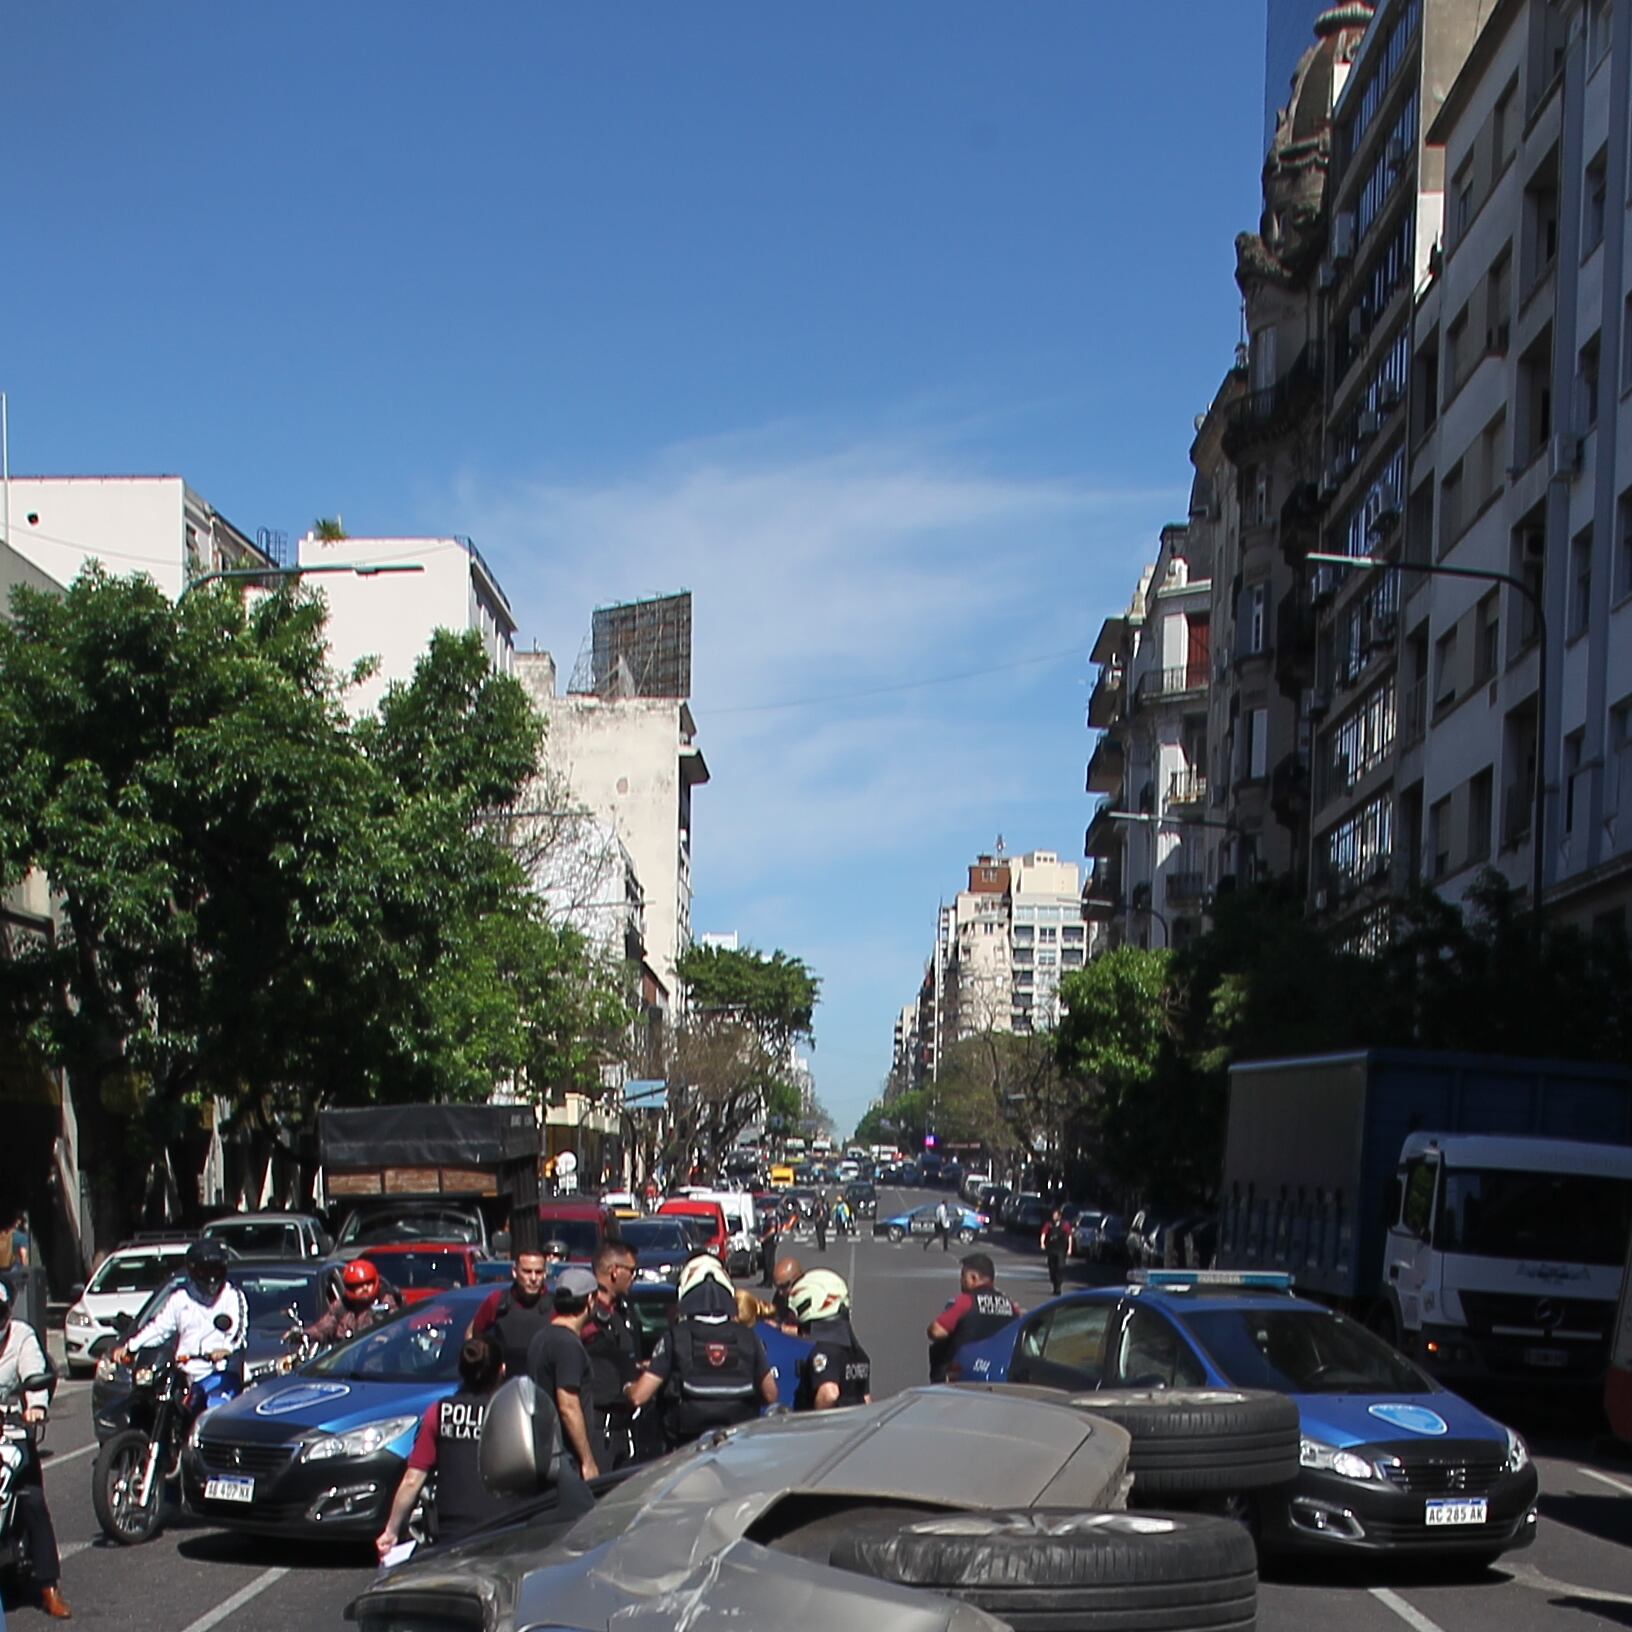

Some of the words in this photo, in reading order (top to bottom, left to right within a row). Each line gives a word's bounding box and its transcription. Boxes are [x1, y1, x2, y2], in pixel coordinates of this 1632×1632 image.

[440, 1402, 483, 1426] POLI
[440, 1423, 453, 1438] DE
[456, 1425, 471, 1439] LA
[1429, 1507, 1443, 1522] AC
[1447, 1507, 1466, 1521] 285
[1470, 1506, 1484, 1520] AK
